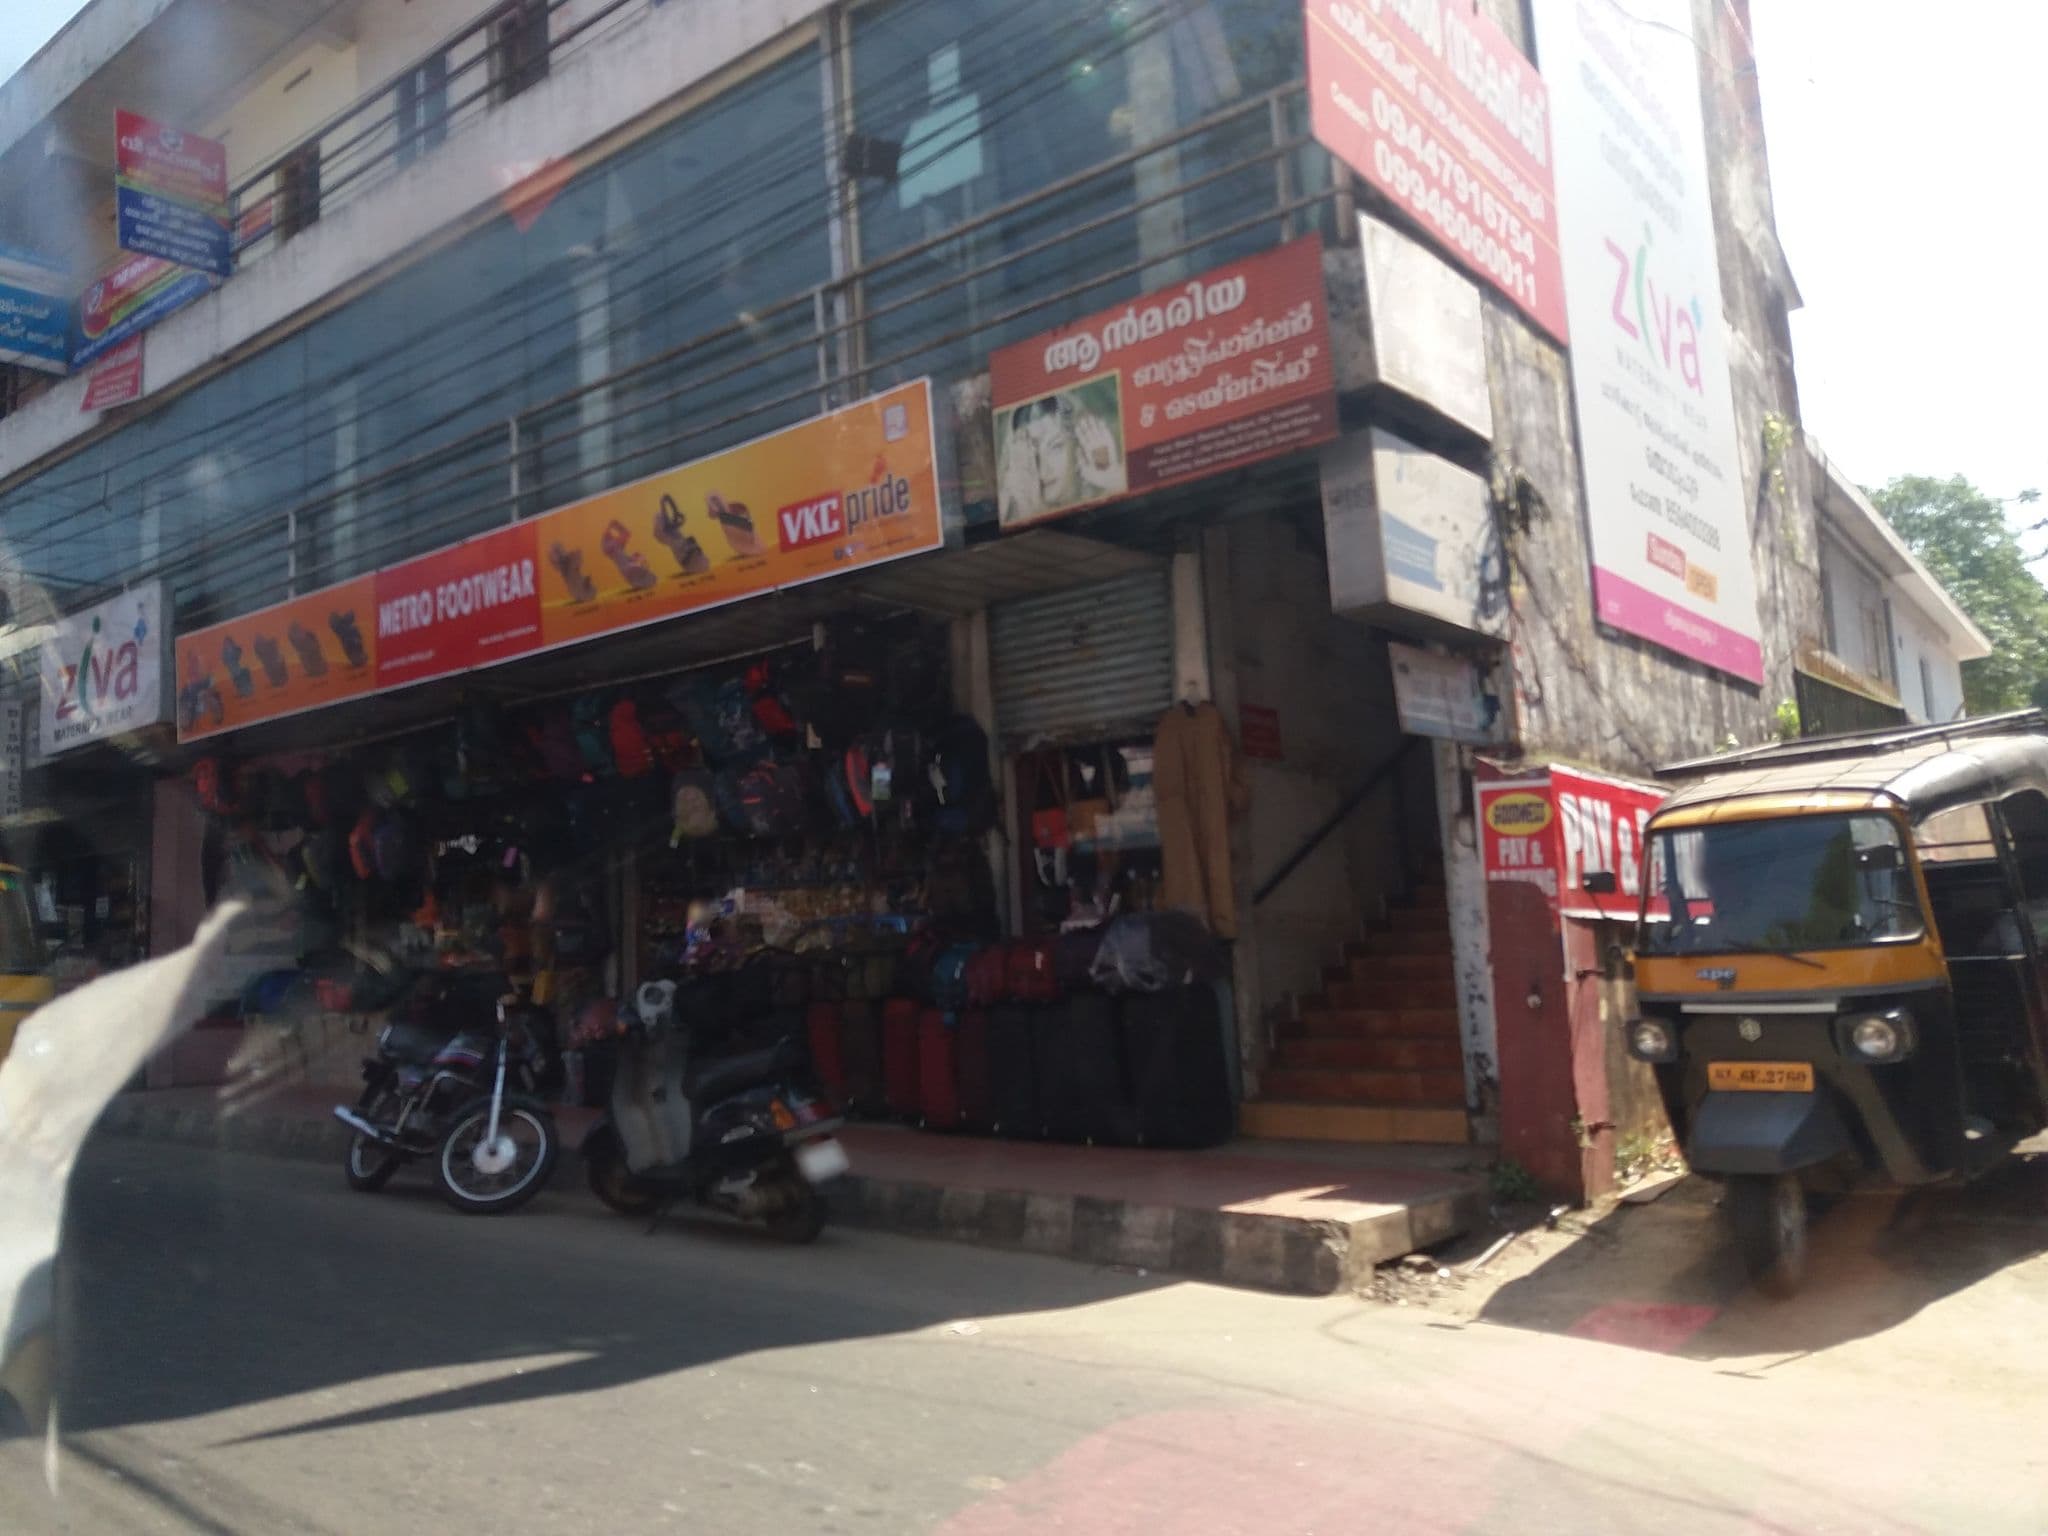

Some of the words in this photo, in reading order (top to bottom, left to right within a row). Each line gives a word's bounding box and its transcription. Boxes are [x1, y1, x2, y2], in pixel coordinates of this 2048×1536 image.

[783, 497, 841, 545] VKC
[846, 468, 909, 536] pride
[378, 588, 433, 639] METRO
[436, 558, 536, 623] FOOTWEAR
[1497, 838, 1529, 867] PAY
[1558, 792, 1613, 890] PAY
